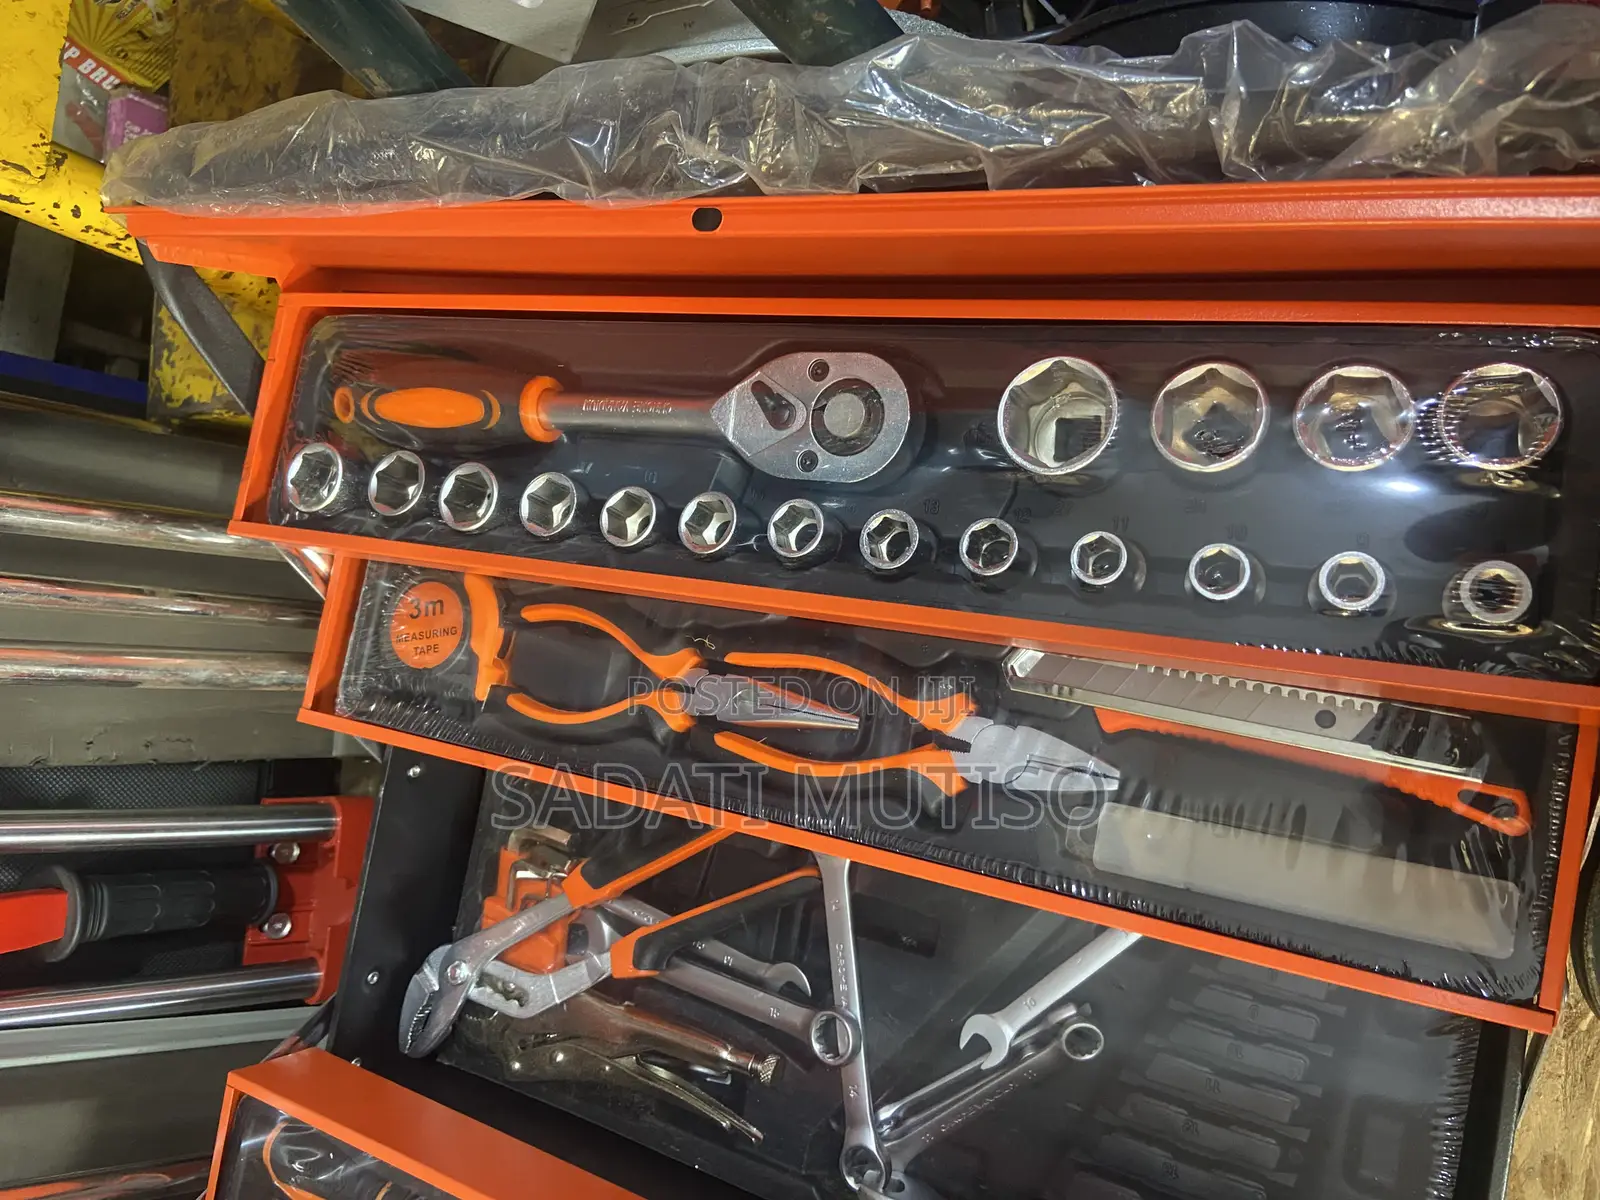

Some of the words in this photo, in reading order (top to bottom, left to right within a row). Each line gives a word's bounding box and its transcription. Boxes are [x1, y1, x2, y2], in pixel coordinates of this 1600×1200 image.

[409, 597, 445, 620] 3m
[395, 626, 458, 644] MEASURING
[413, 643, 440, 657] TAPE
